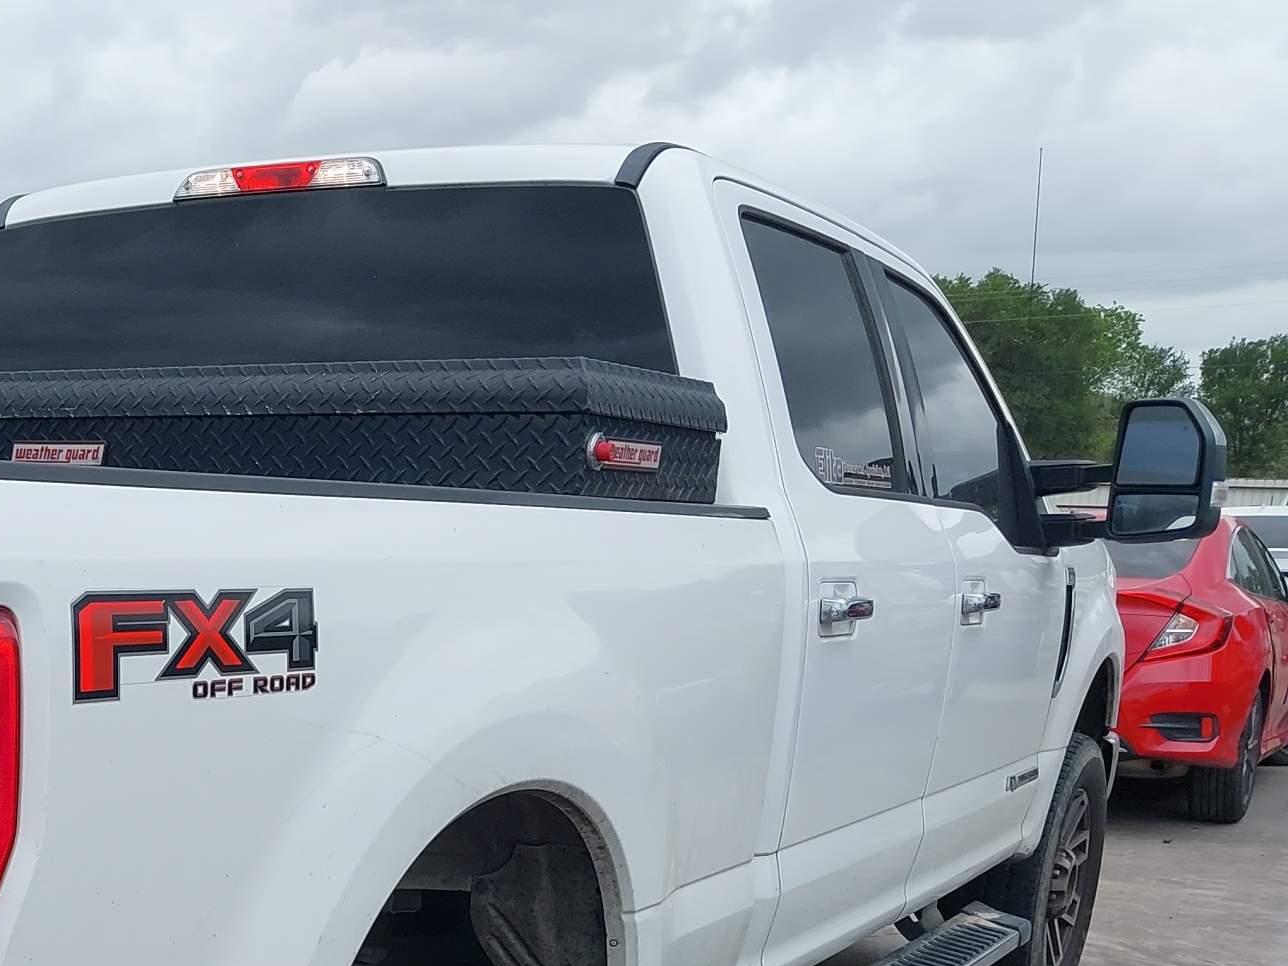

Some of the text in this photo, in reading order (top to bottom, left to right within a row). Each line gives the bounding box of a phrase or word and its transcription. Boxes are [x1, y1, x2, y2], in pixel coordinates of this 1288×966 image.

[14, 445, 101, 463] weather guard
[611, 443, 661, 464] eather guard
[70, 587, 319, 705] FX4
[191, 671, 317, 701] OFF ROAD
